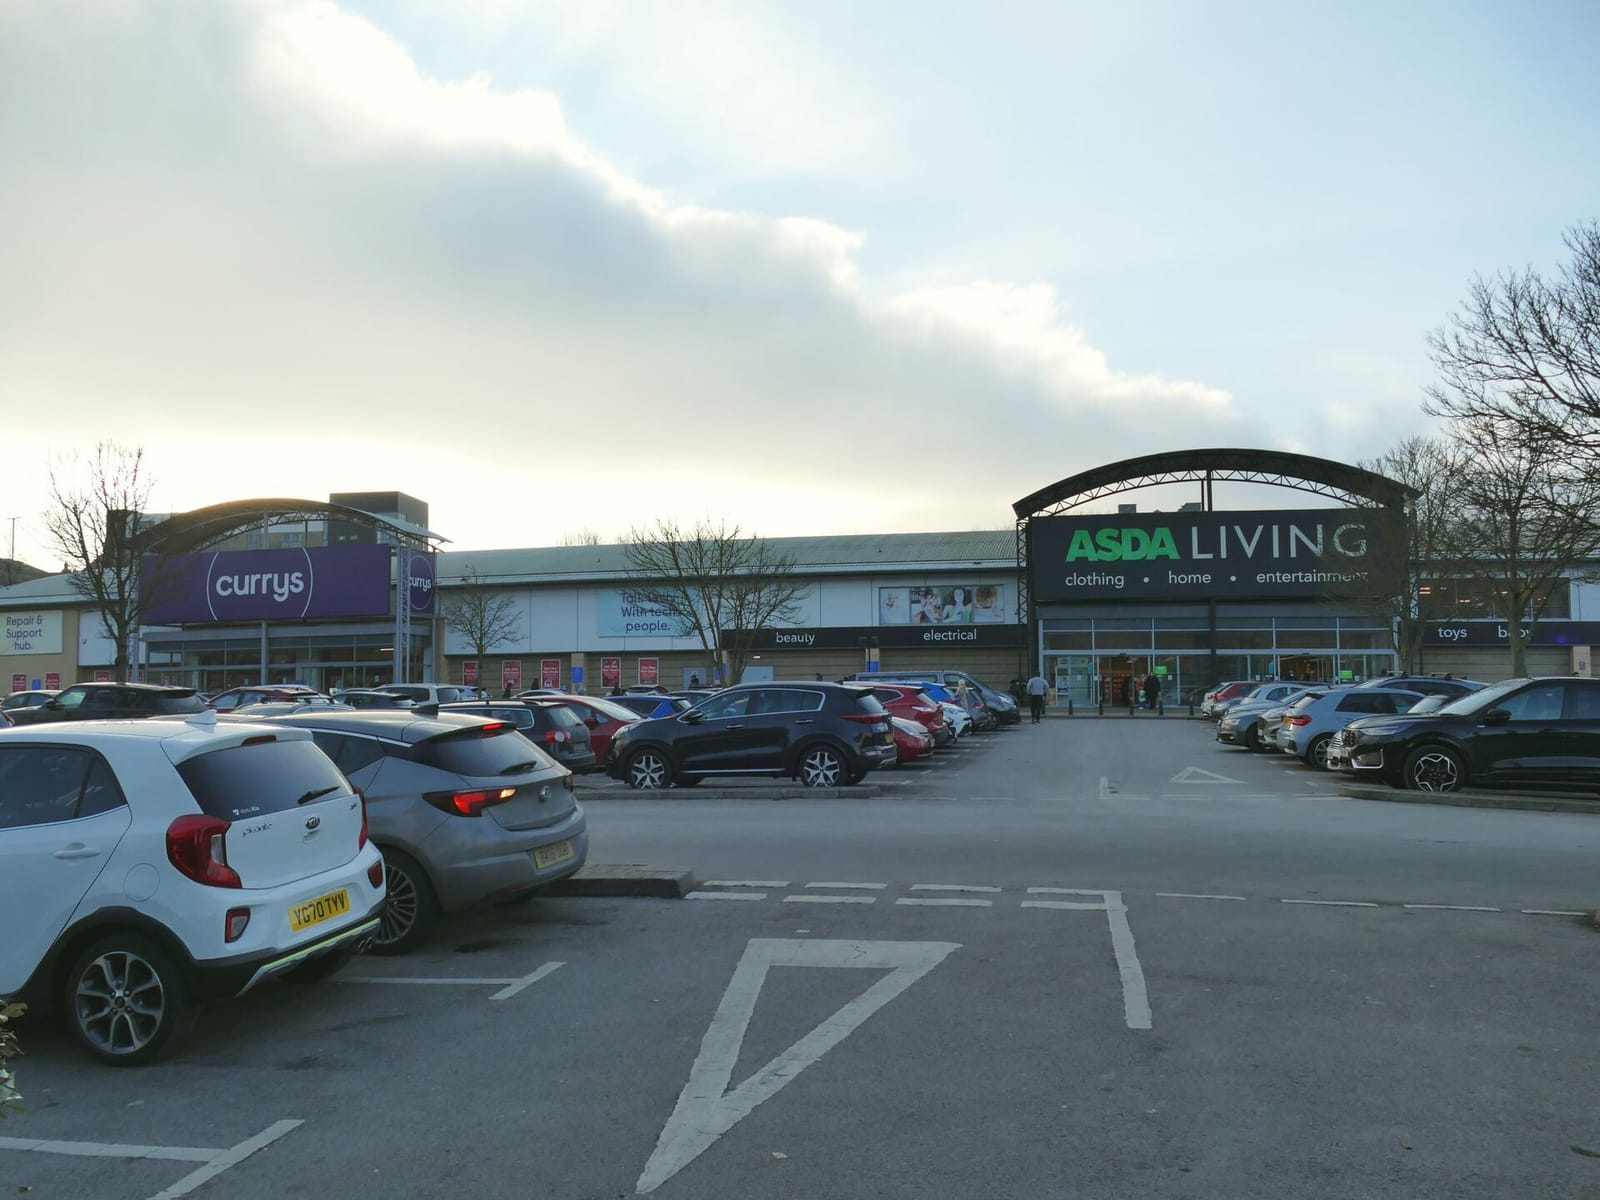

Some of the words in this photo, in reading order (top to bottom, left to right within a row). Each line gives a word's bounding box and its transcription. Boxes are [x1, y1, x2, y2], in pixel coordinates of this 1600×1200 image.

[1065, 527, 1181, 562] ASDA
[1191, 524, 1367, 559] LIVING
[215, 571, 305, 602] currys
[1065, 572, 1125, 589] clothing
[1168, 570, 1212, 585] home
[621, 606, 647, 617] With
[7, 616, 34, 628] Repair
[36, 615, 43, 625] &
[625, 620, 671, 634] people.
[7, 629, 42, 640] Support
[775, 631, 816, 645] beauty
[923, 628, 978, 642] electrical
[1437, 627, 1468, 641] toys
[294, 902, 325, 926] YG70
